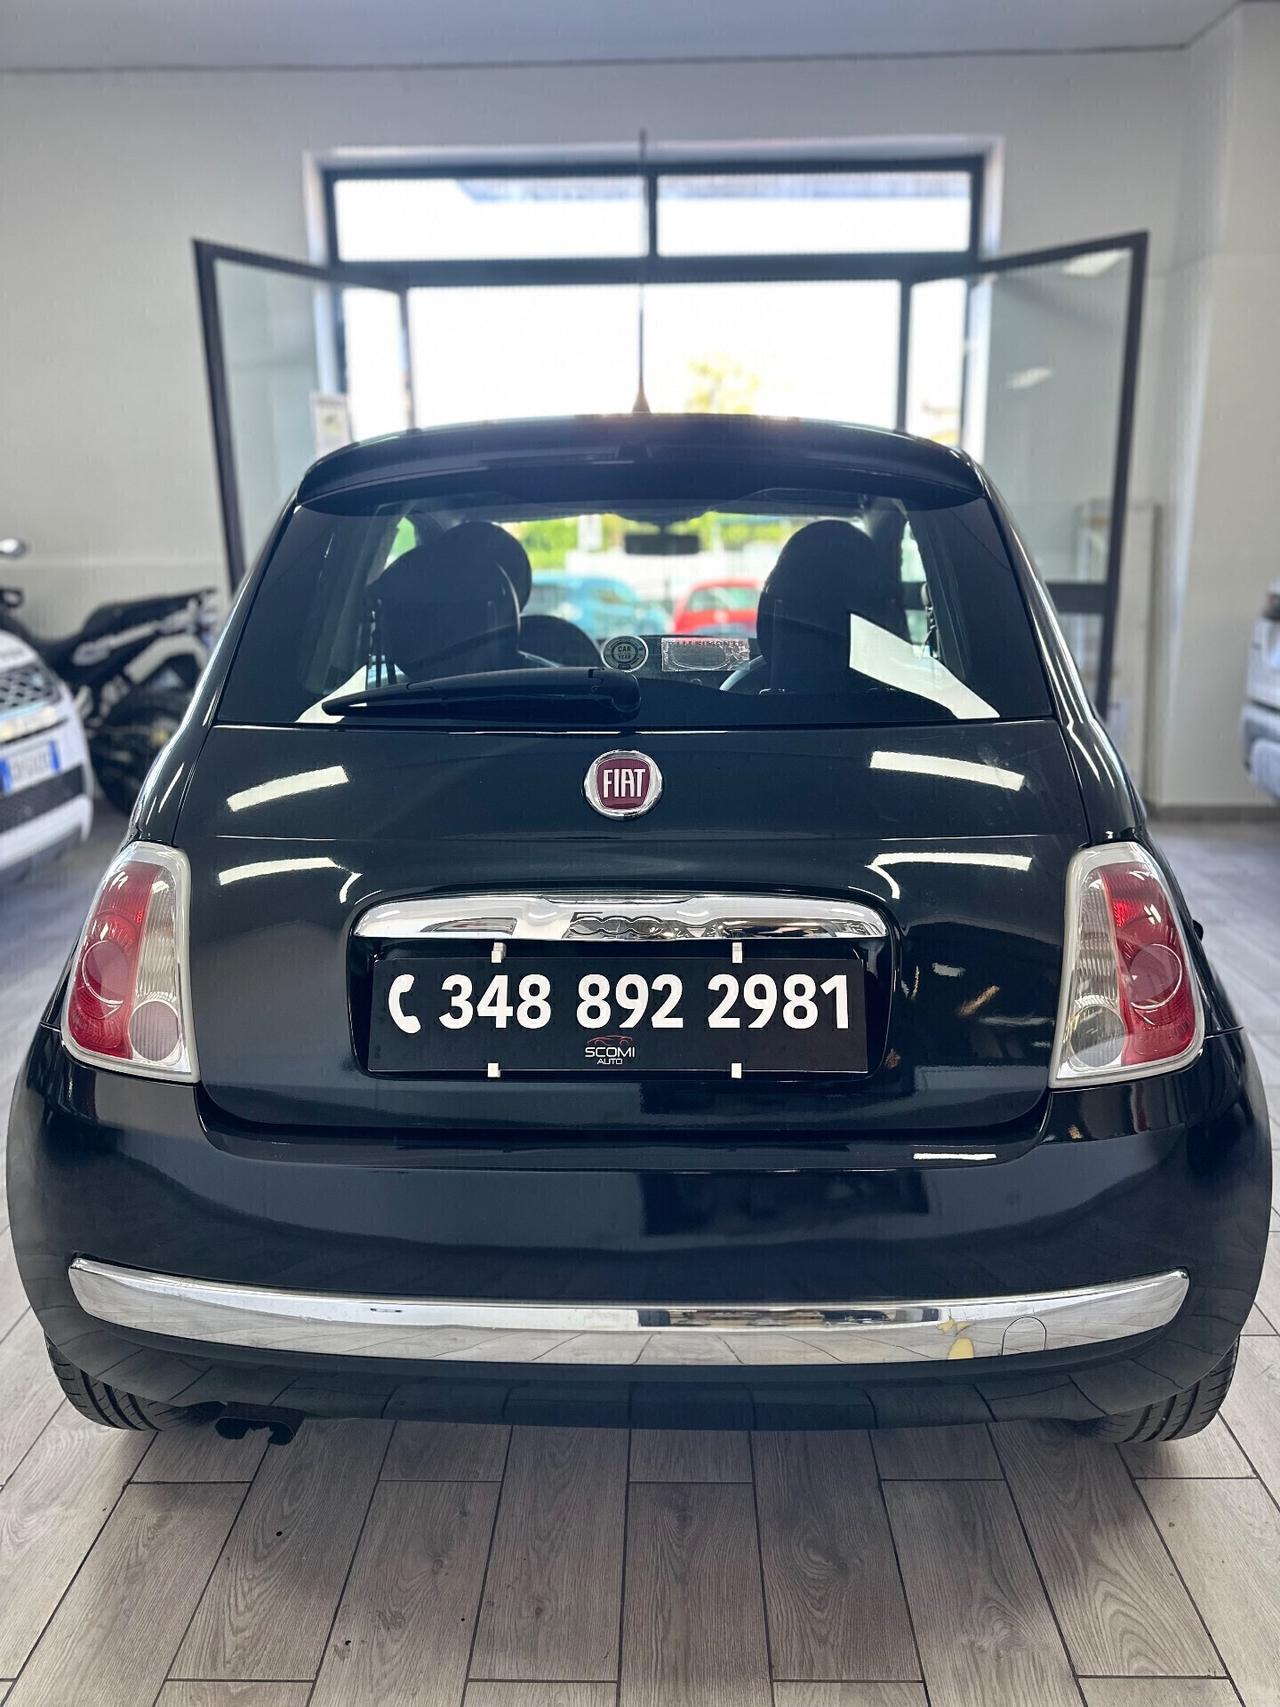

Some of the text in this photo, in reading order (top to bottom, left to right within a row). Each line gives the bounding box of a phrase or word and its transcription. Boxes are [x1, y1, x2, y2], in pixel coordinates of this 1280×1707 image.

[603, 768, 646, 798] FIAT
[438, 973, 849, 1030] 348 892 2981
[584, 1046, 635, 1058] SCOMI
[596, 1057, 623, 1065] AUTO
